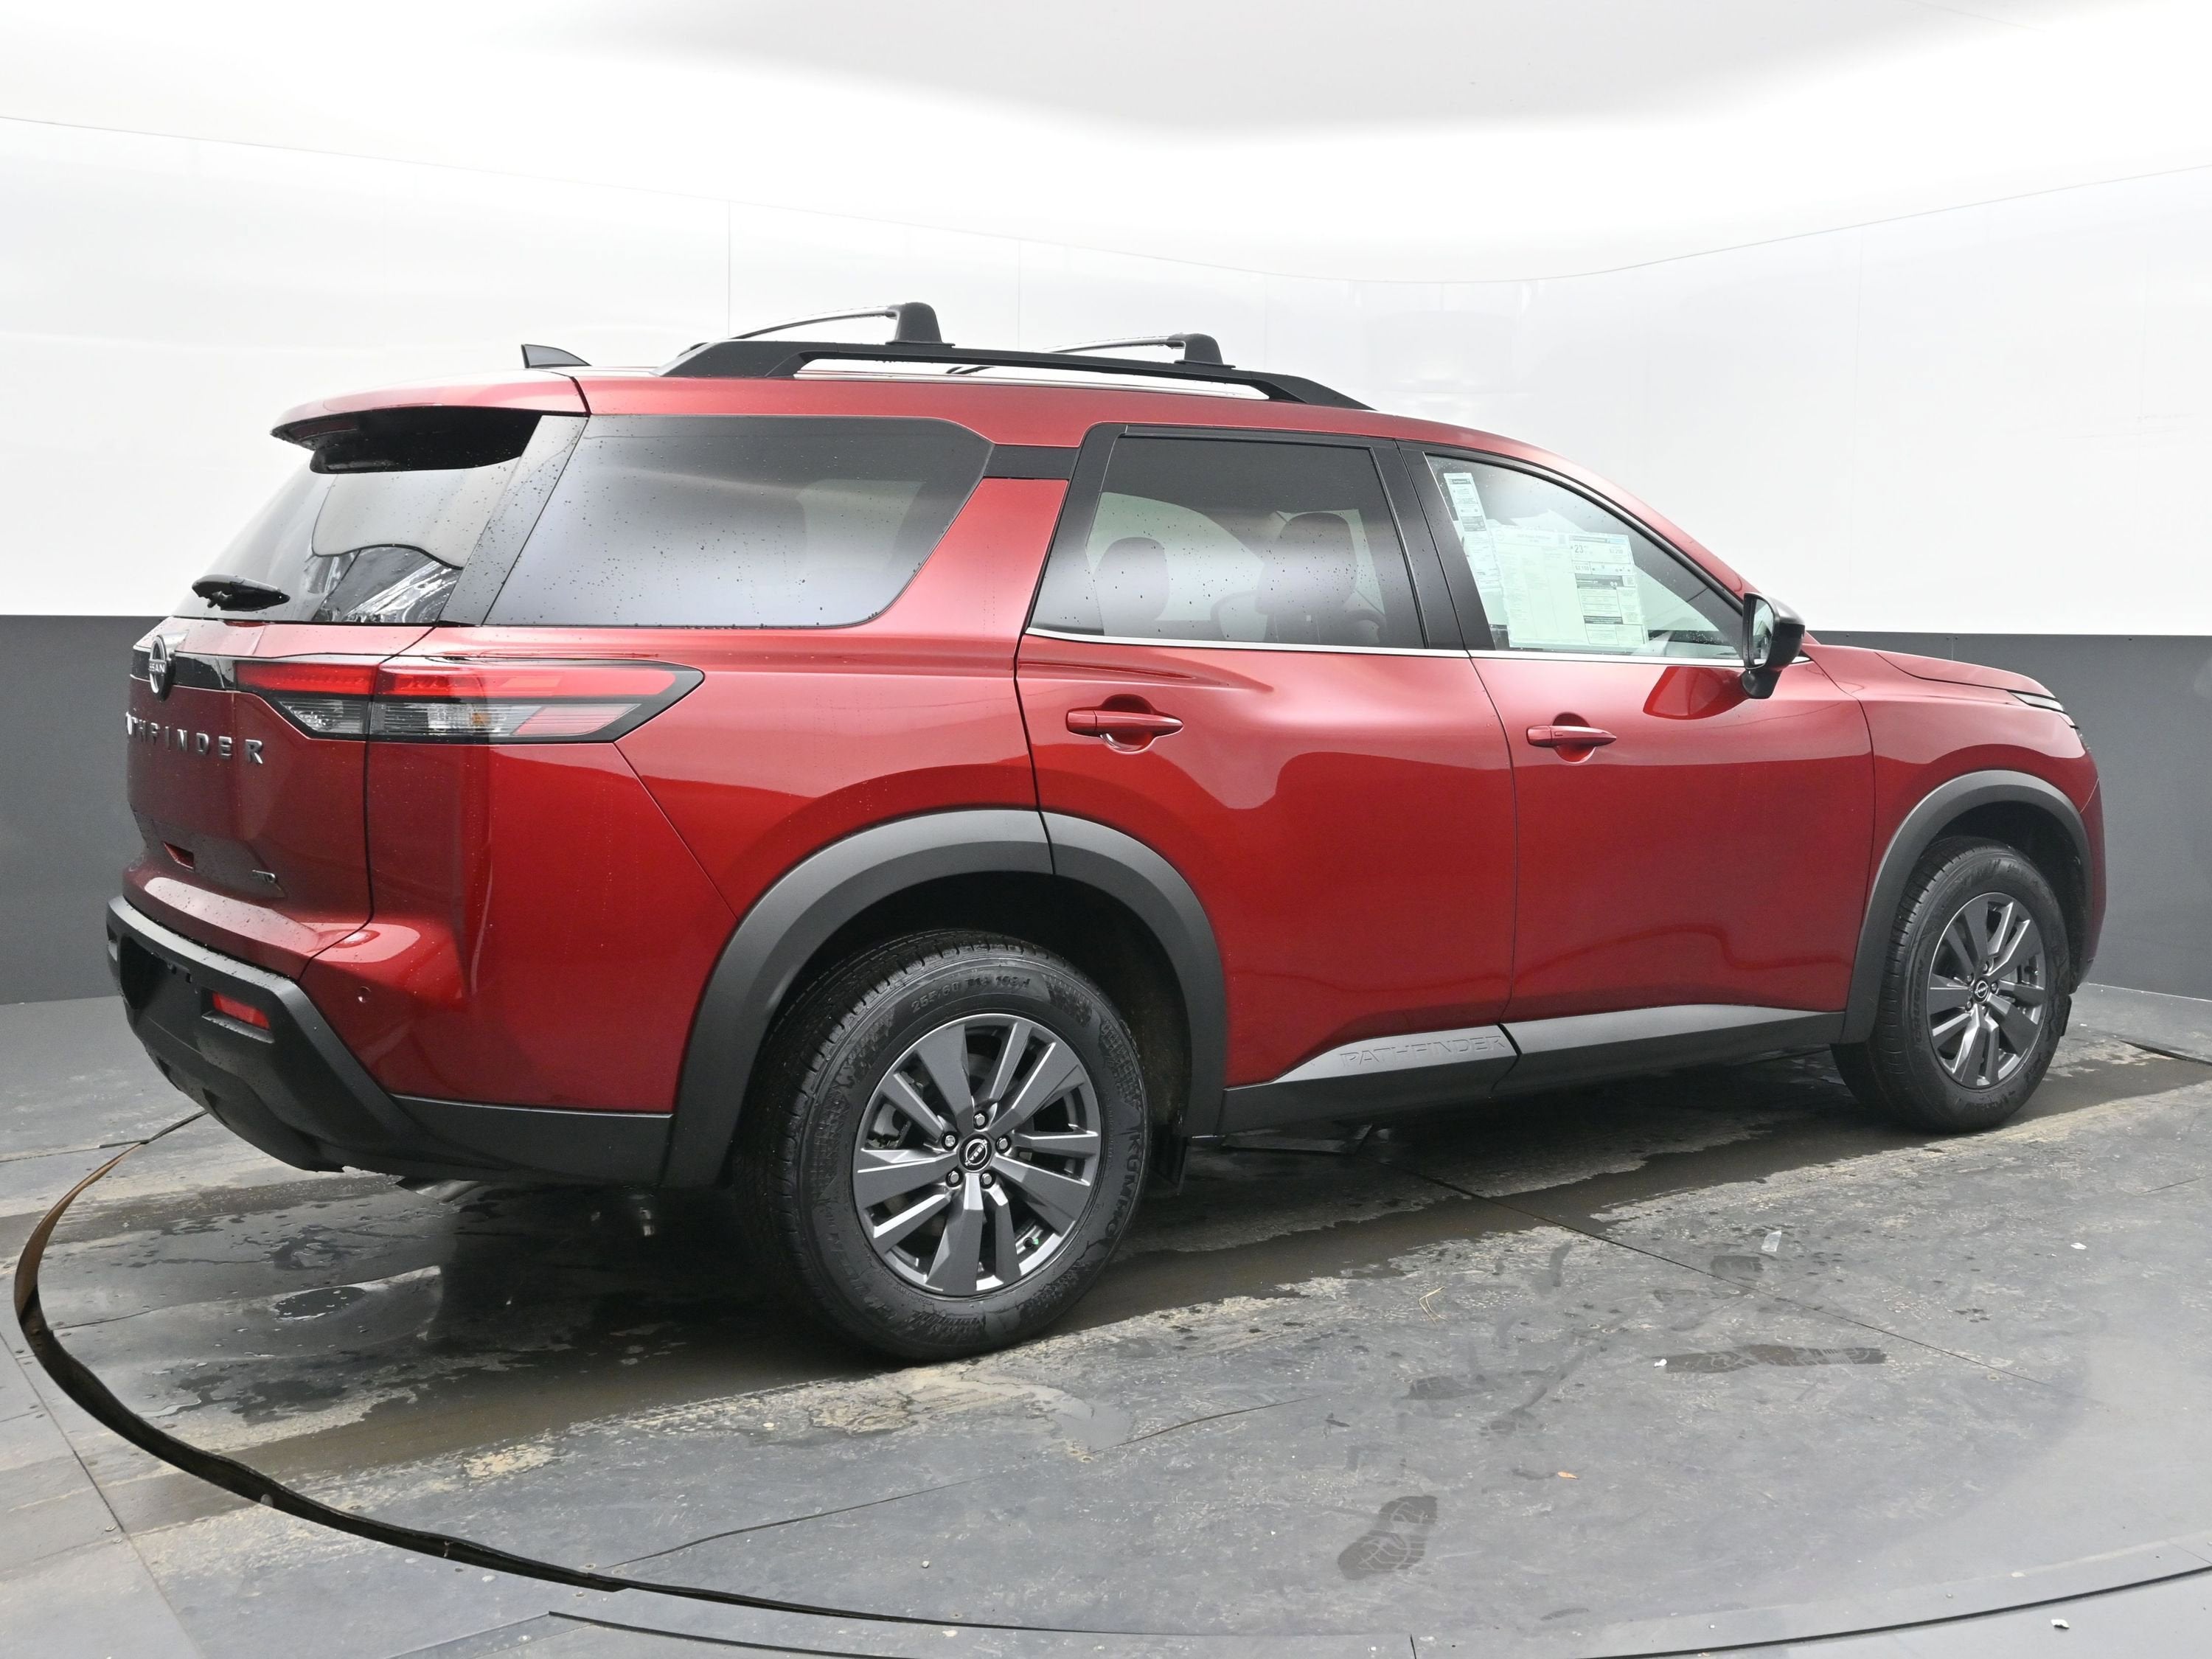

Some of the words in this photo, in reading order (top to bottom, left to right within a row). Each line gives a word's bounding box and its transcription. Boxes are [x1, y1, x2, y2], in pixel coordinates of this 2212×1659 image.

[1574, 544, 1584, 554] 23
[1339, 1035, 1506, 1068] PATHFINDER
[964, 1139, 988, 1166] NISSAN
[1105, 1133, 1142, 1238] KUMHO
